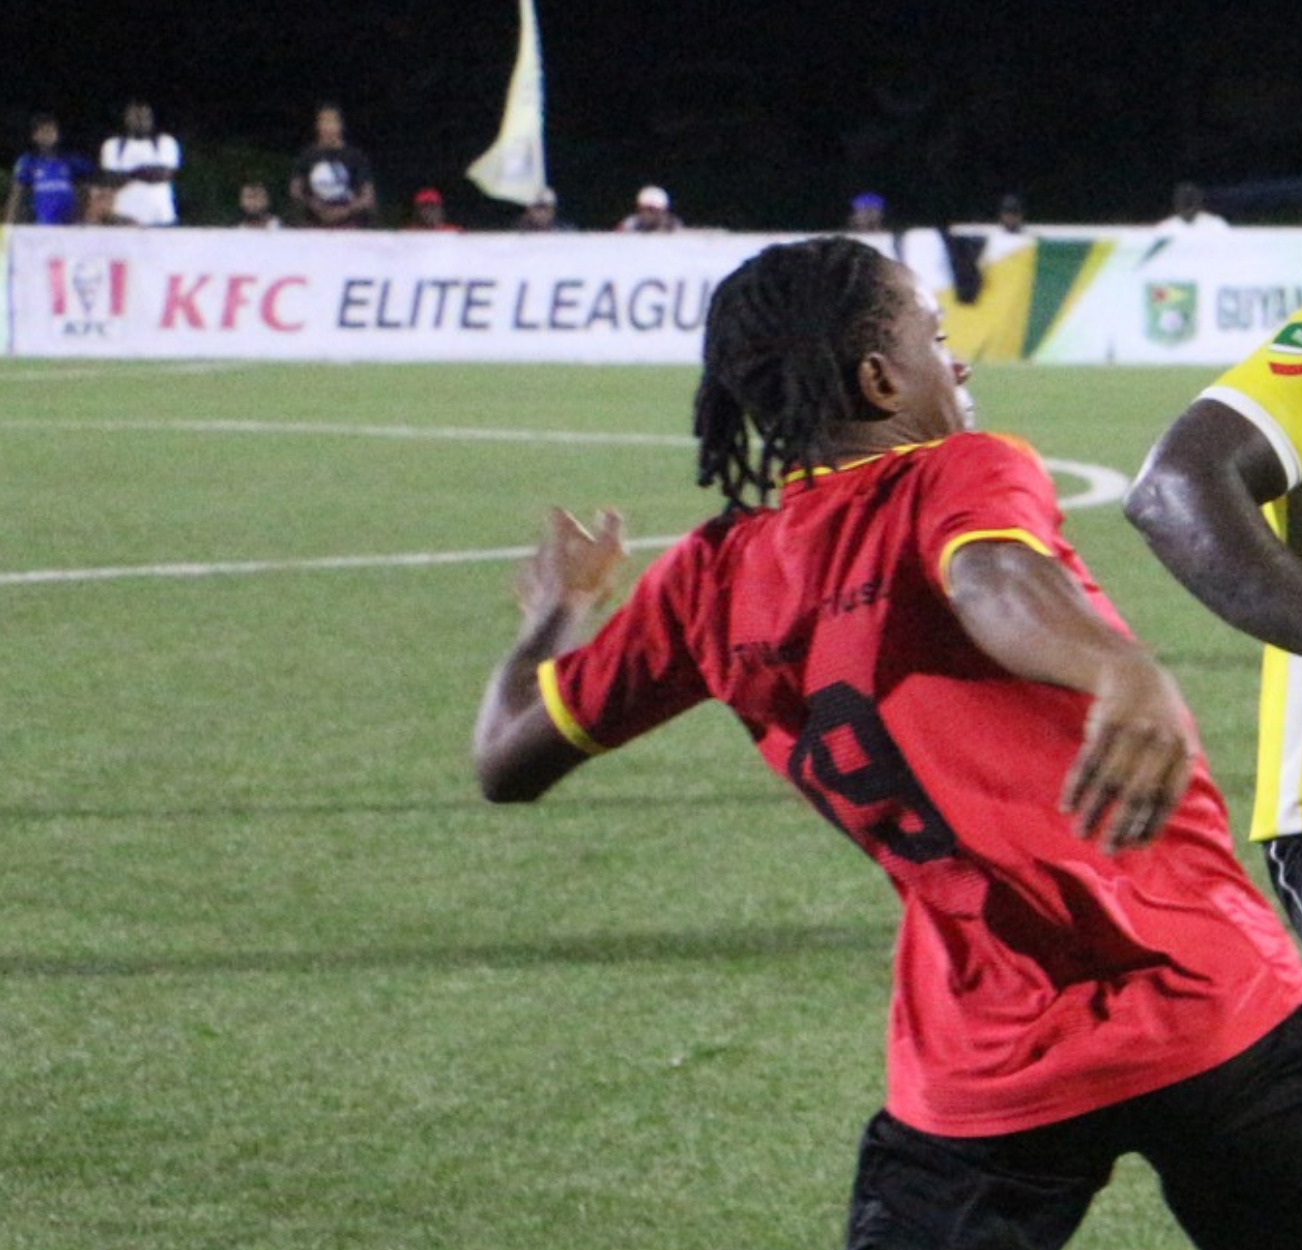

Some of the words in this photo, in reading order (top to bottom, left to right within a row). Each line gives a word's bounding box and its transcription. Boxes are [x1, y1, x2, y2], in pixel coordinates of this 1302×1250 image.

[159, 273, 310, 333] KFC
[336, 278, 497, 330] ELITE
[512, 278, 713, 332] LEAGU
